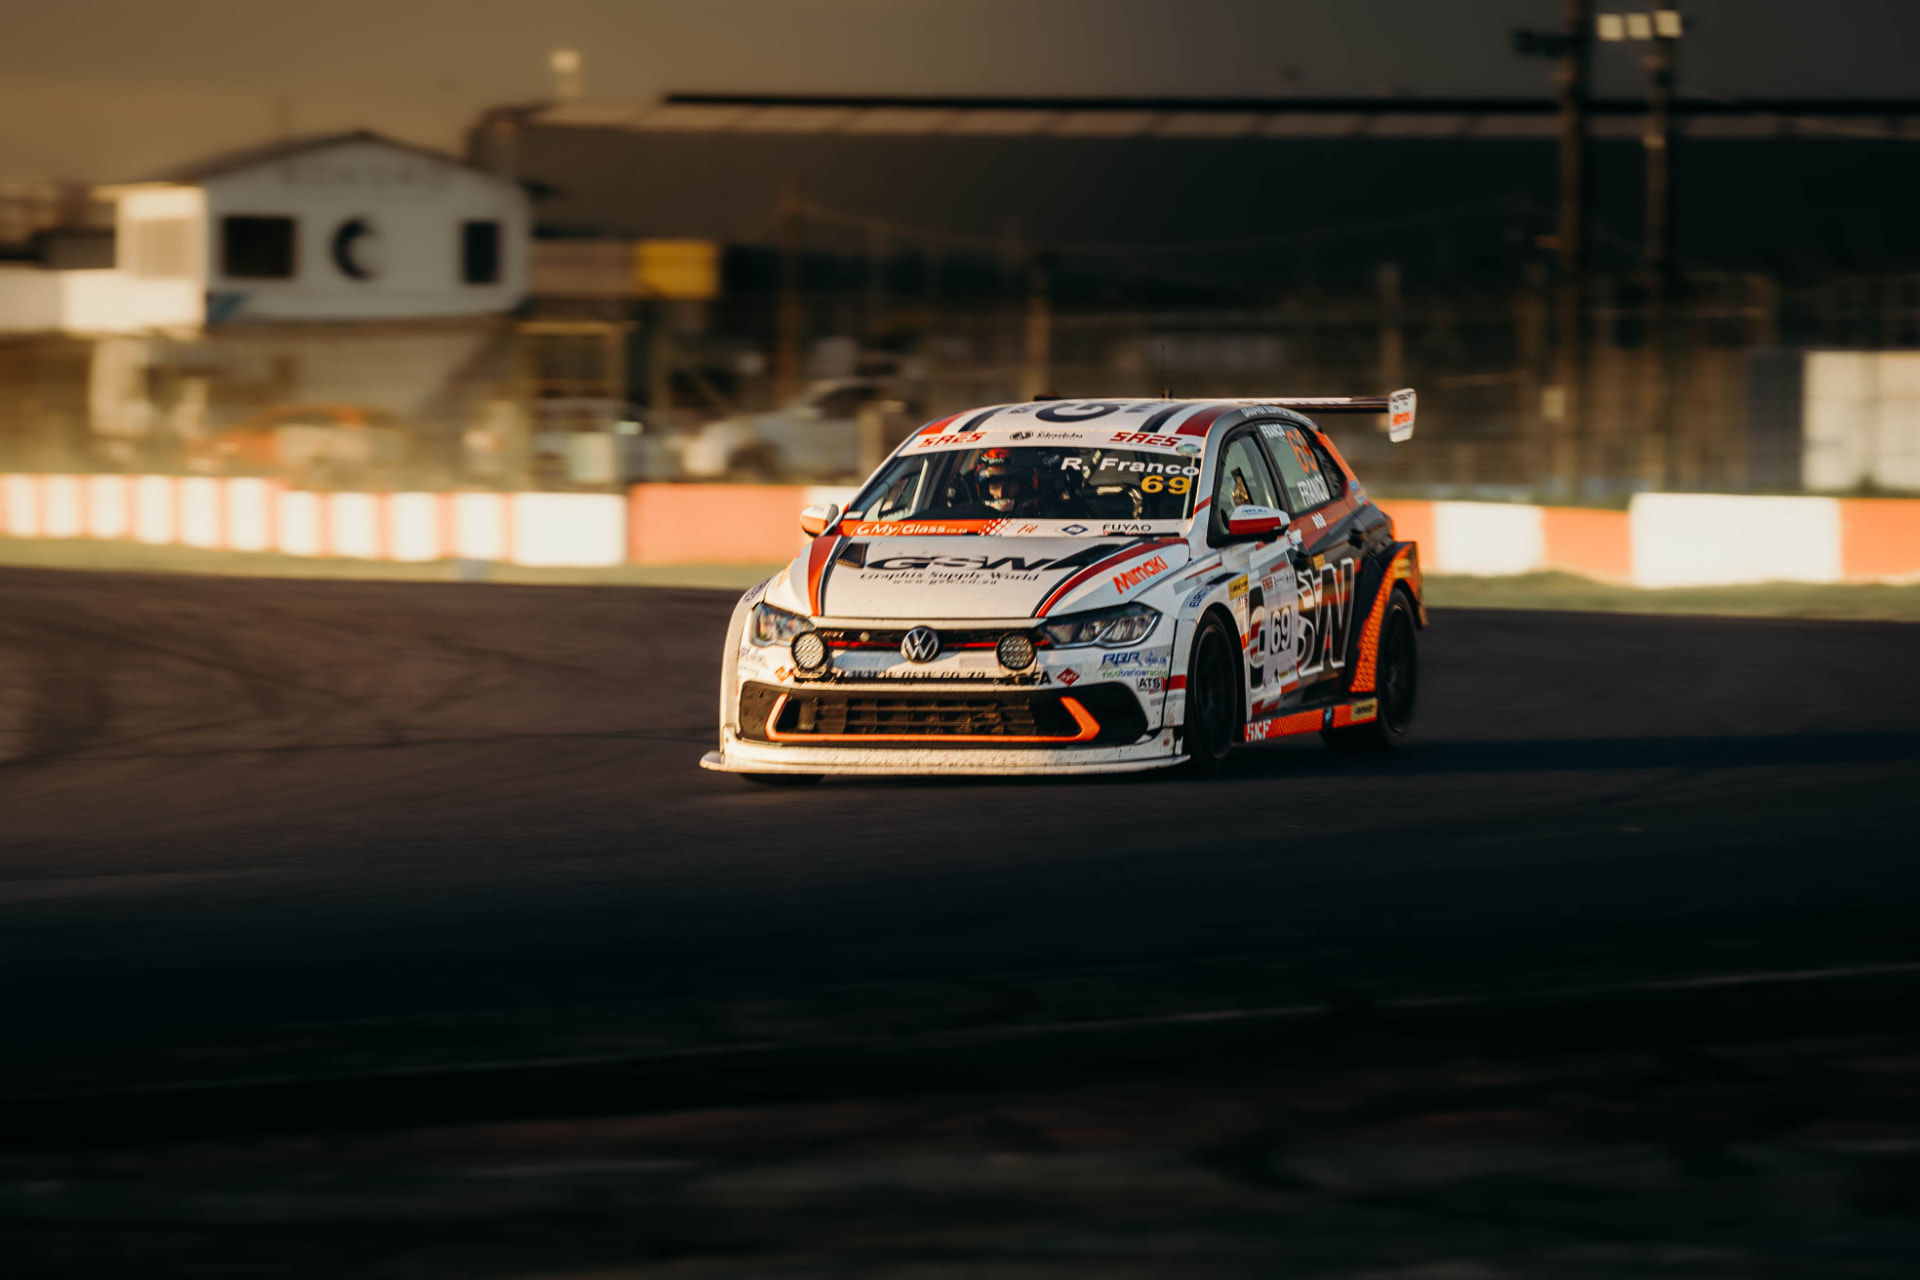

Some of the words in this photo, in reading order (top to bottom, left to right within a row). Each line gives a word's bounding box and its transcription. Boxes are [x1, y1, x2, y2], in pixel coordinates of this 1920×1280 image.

[917, 431, 987, 449] SAES
[1109, 431, 1182, 448] SAES
[1061, 457, 1089, 471] R.
[1100, 457, 1200, 476] Franco
[1141, 475, 1191, 495] 69
[1102, 524, 1152, 533] FUYAO
[866, 555, 1058, 572] GSW
[928, 571, 982, 582] Supply
[990, 572, 1041, 582] World
[1270, 606, 1292, 655] 69
[1246, 719, 1272, 743] SKF
